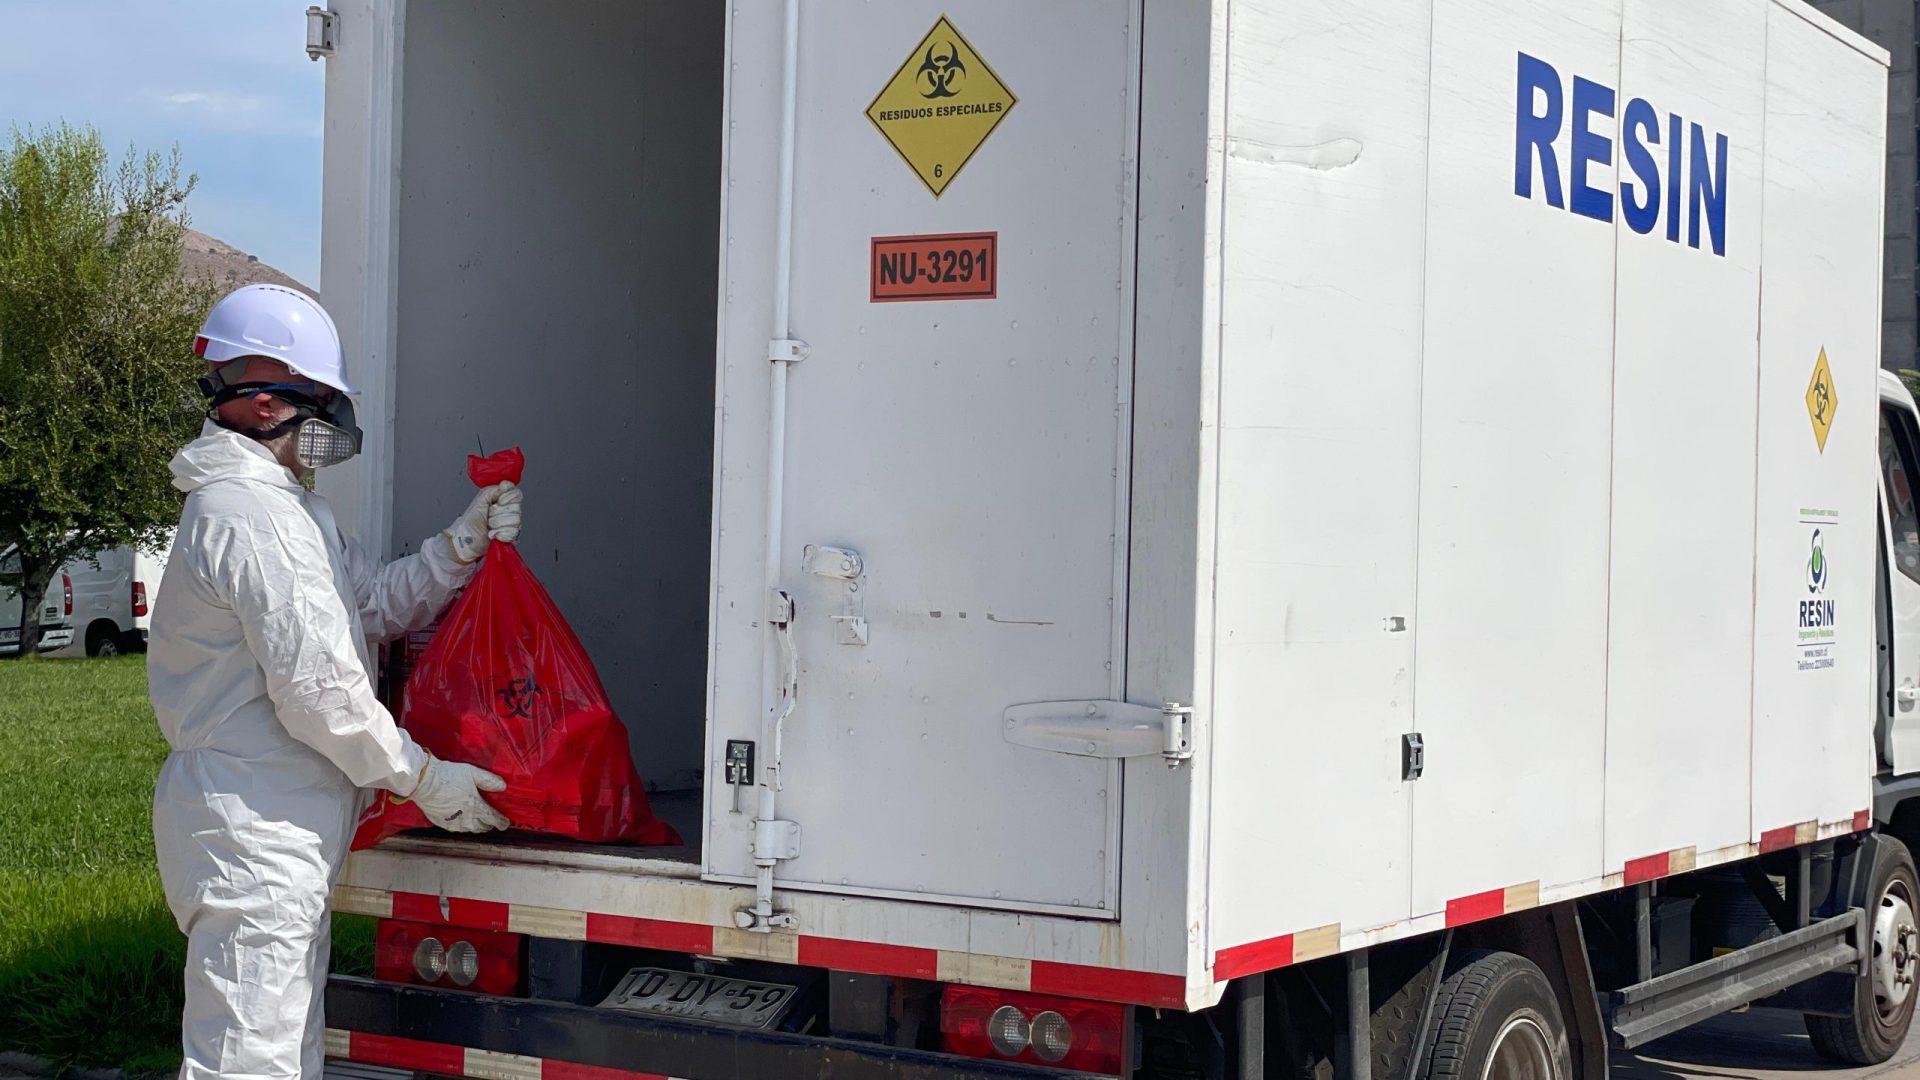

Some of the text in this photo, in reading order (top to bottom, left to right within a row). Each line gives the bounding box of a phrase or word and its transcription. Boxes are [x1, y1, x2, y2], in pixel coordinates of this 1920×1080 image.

[880, 102, 1003, 120] RESIDUOS ESPECIALES
[1514, 50, 1728, 258] RESIN
[933, 163, 943, 178] 6
[880, 248, 987, 285] NU-3291
[1799, 600, 1834, 627] RESIN
